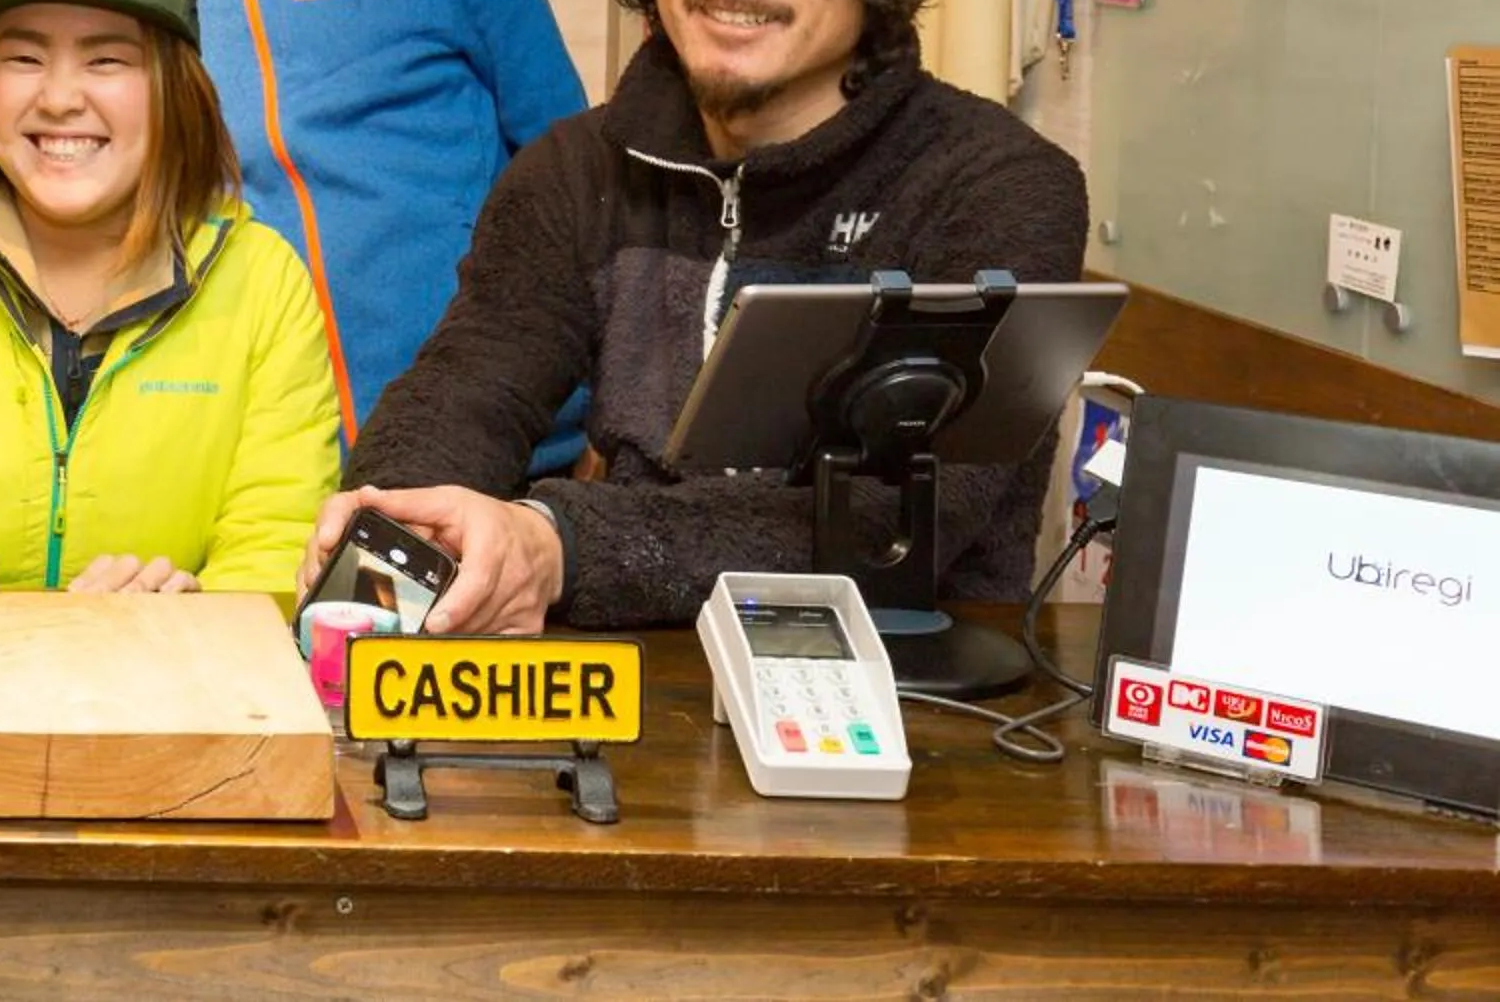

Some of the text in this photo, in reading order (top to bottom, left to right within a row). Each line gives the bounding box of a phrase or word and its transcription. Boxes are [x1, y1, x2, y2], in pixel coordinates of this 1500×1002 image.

[1328, 551, 1474, 607] Ubiregi
[374, 659, 616, 719] CASHIER
[1171, 683, 1208, 712] DC
[1189, 724, 1236, 748] VISA
